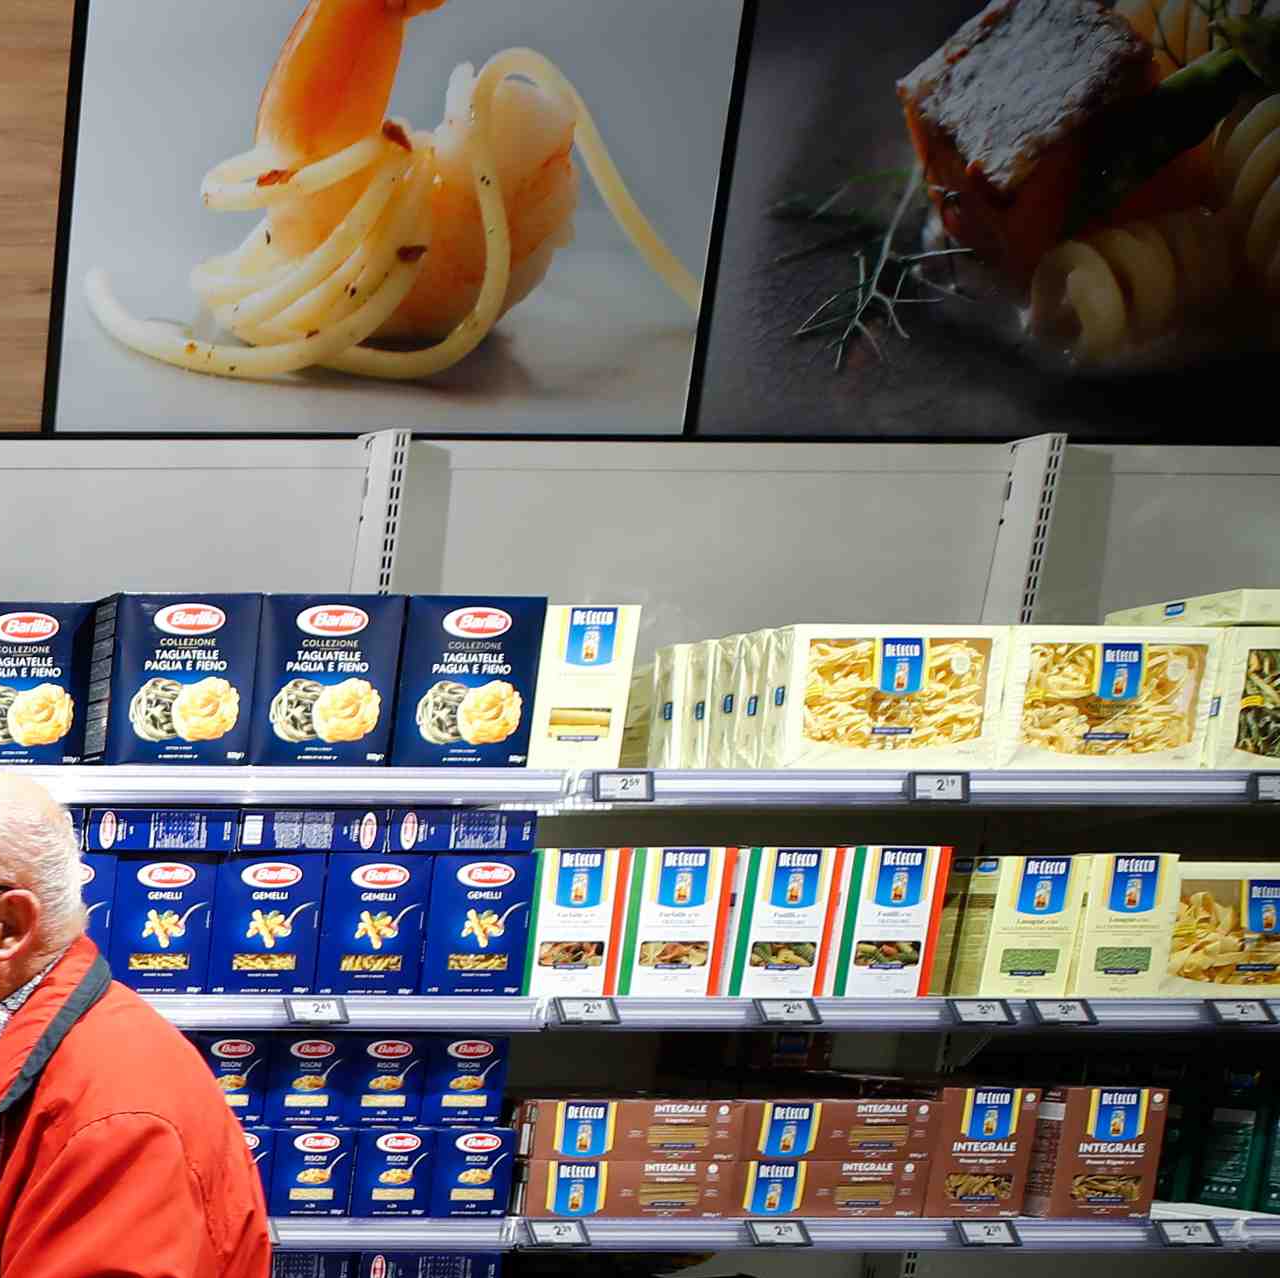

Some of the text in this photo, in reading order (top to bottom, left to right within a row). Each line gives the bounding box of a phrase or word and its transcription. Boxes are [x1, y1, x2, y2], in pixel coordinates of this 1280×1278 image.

[316, 610, 362, 628] Barilla
[302, 638, 359, 649] COLLEZIONE
[296, 650, 361, 663] TAGLIATELLE
[286, 660, 368, 673] PAGLIA E FIENO
[252, 891, 288, 901] GEMELLI
[467, 890, 502, 900] GEMELLI
[654, 1104, 707, 1114] INTEGRALE
[857, 1104, 908, 1113] INTEGRALE
[952, 1141, 1017, 1153] INTEGRALE
[1078, 1142, 1145, 1154] INTEGRALE
